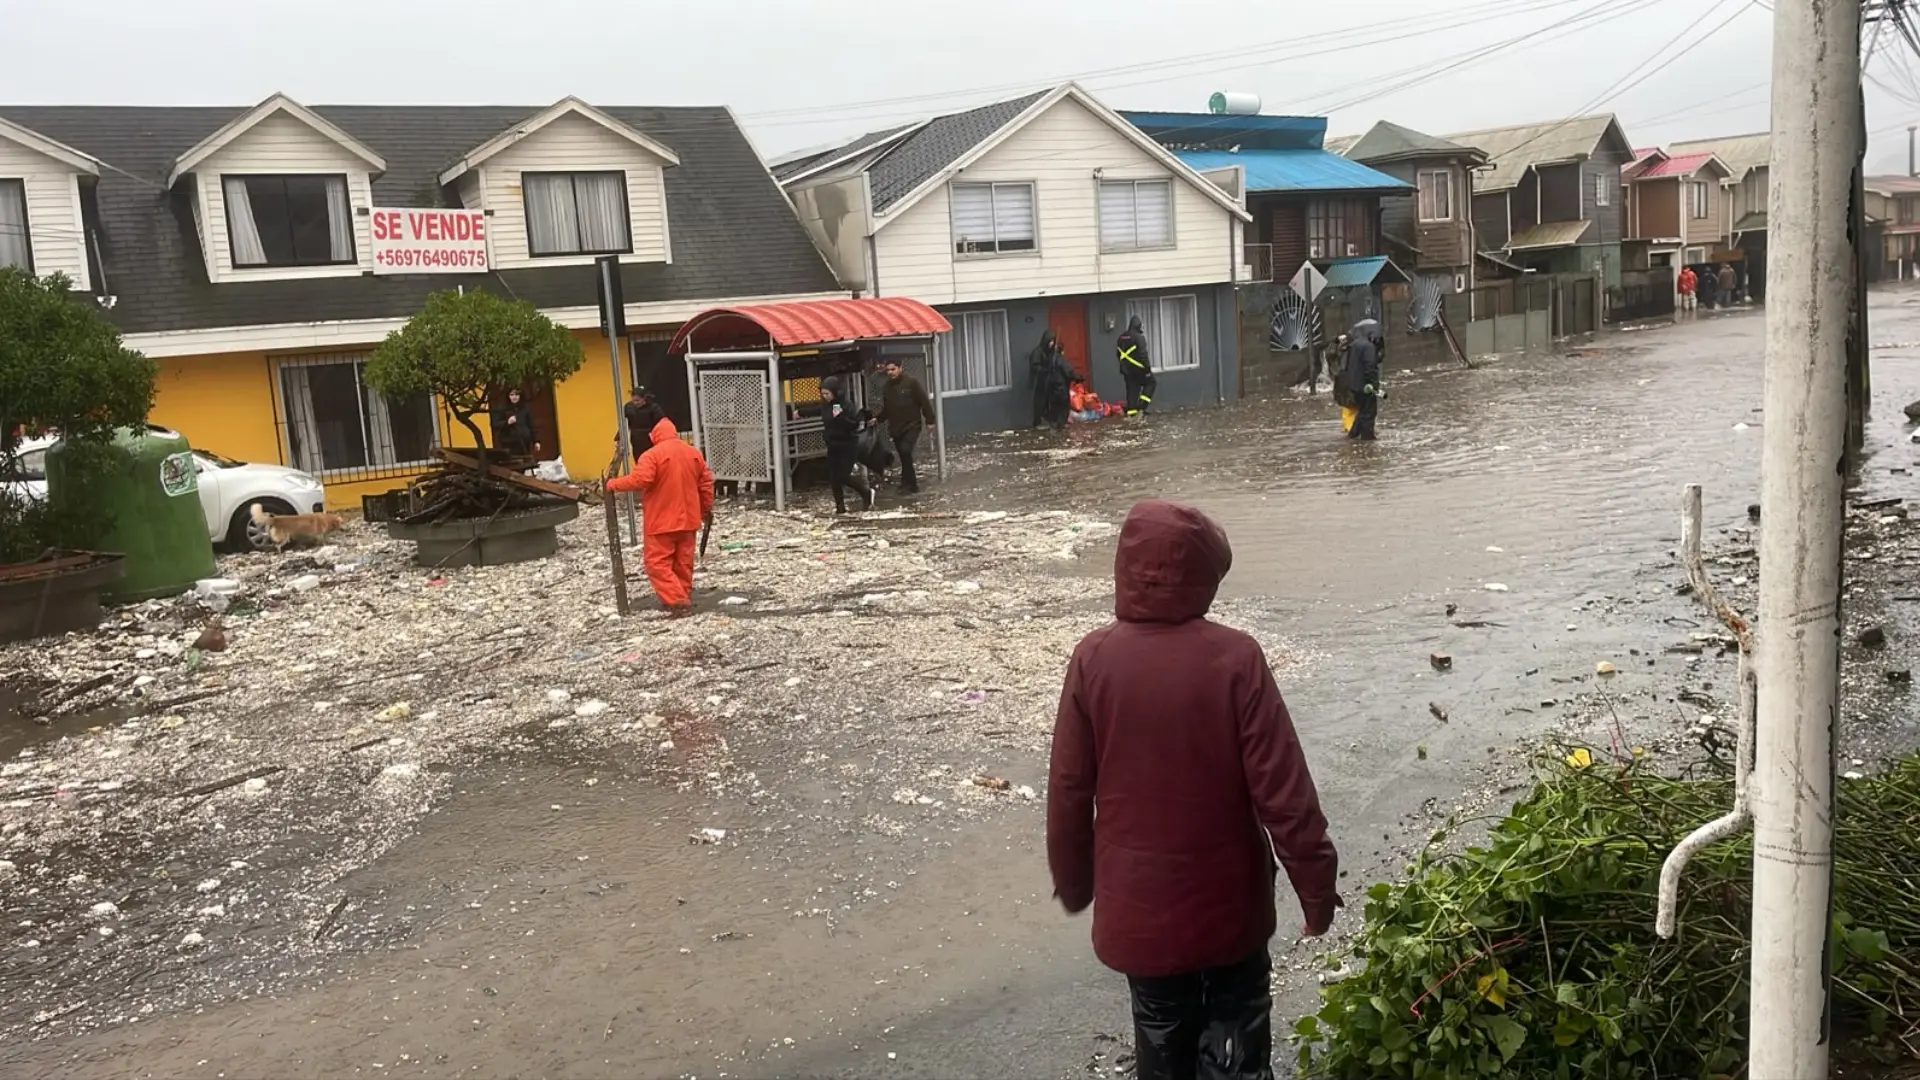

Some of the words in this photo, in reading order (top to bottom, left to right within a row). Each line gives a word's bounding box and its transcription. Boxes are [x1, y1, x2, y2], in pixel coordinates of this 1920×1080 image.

[373, 212, 402, 240] SE
[408, 213, 485, 240] VENDE
[376, 249, 485, 266] +56976490675
